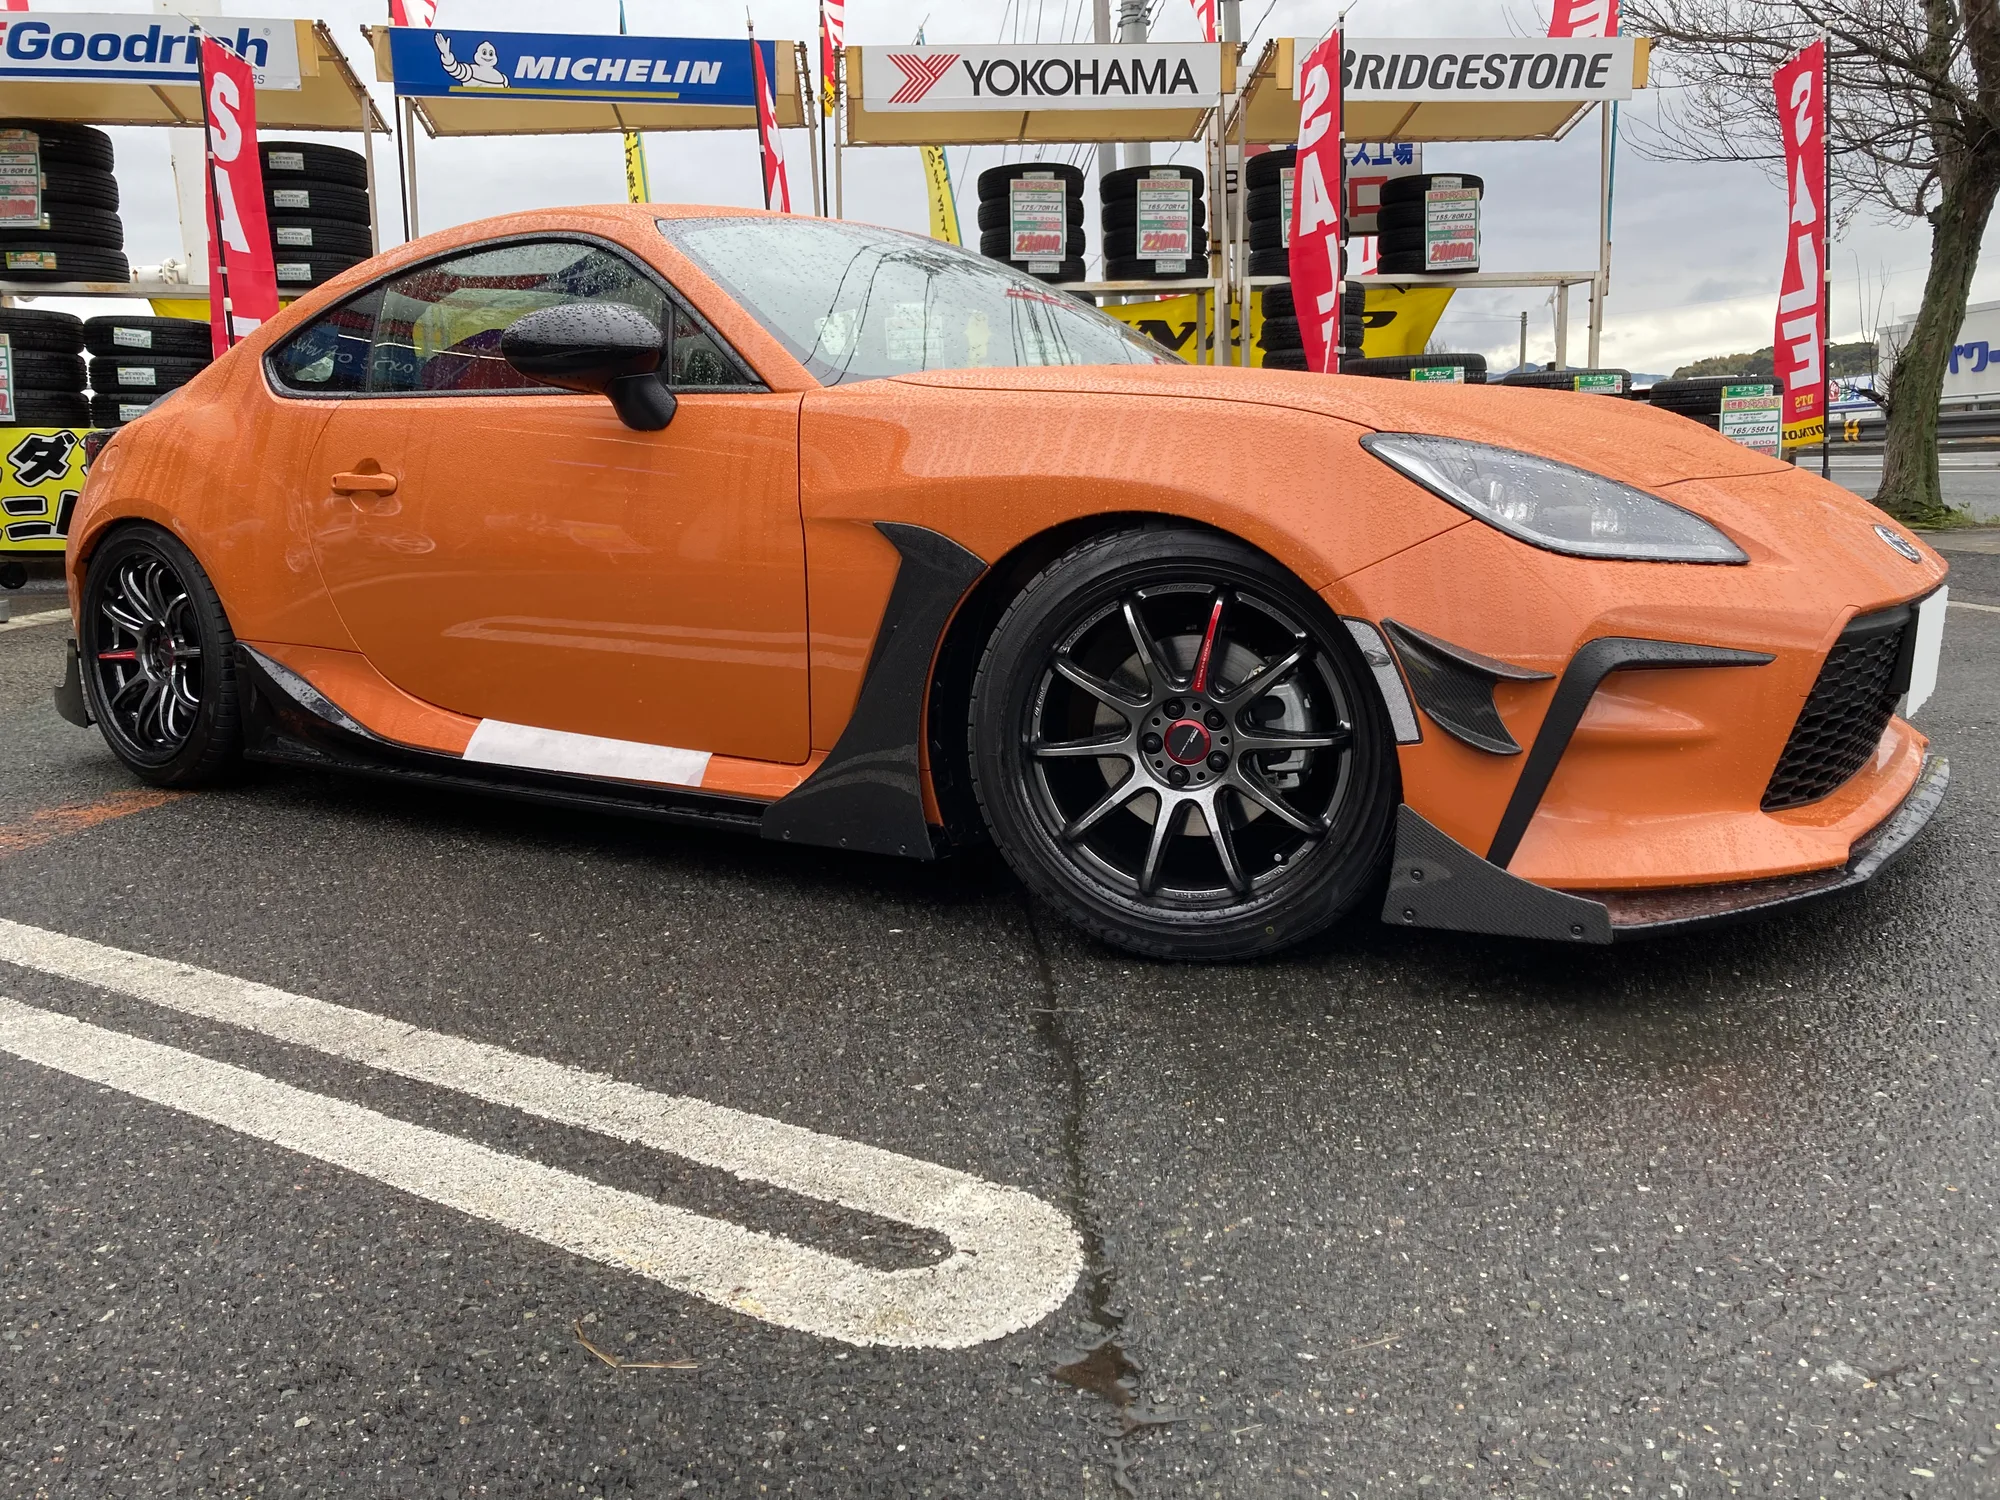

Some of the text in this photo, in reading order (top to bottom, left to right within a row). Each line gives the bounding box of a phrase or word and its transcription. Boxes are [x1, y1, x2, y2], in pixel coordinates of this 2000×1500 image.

[0, 22, 268, 67] Goodrih
[514, 55, 723, 85] MICHELIN
[962, 58, 1199, 97] YOKOHAMA
[1732, 425, 1775, 435] 165/55R14
